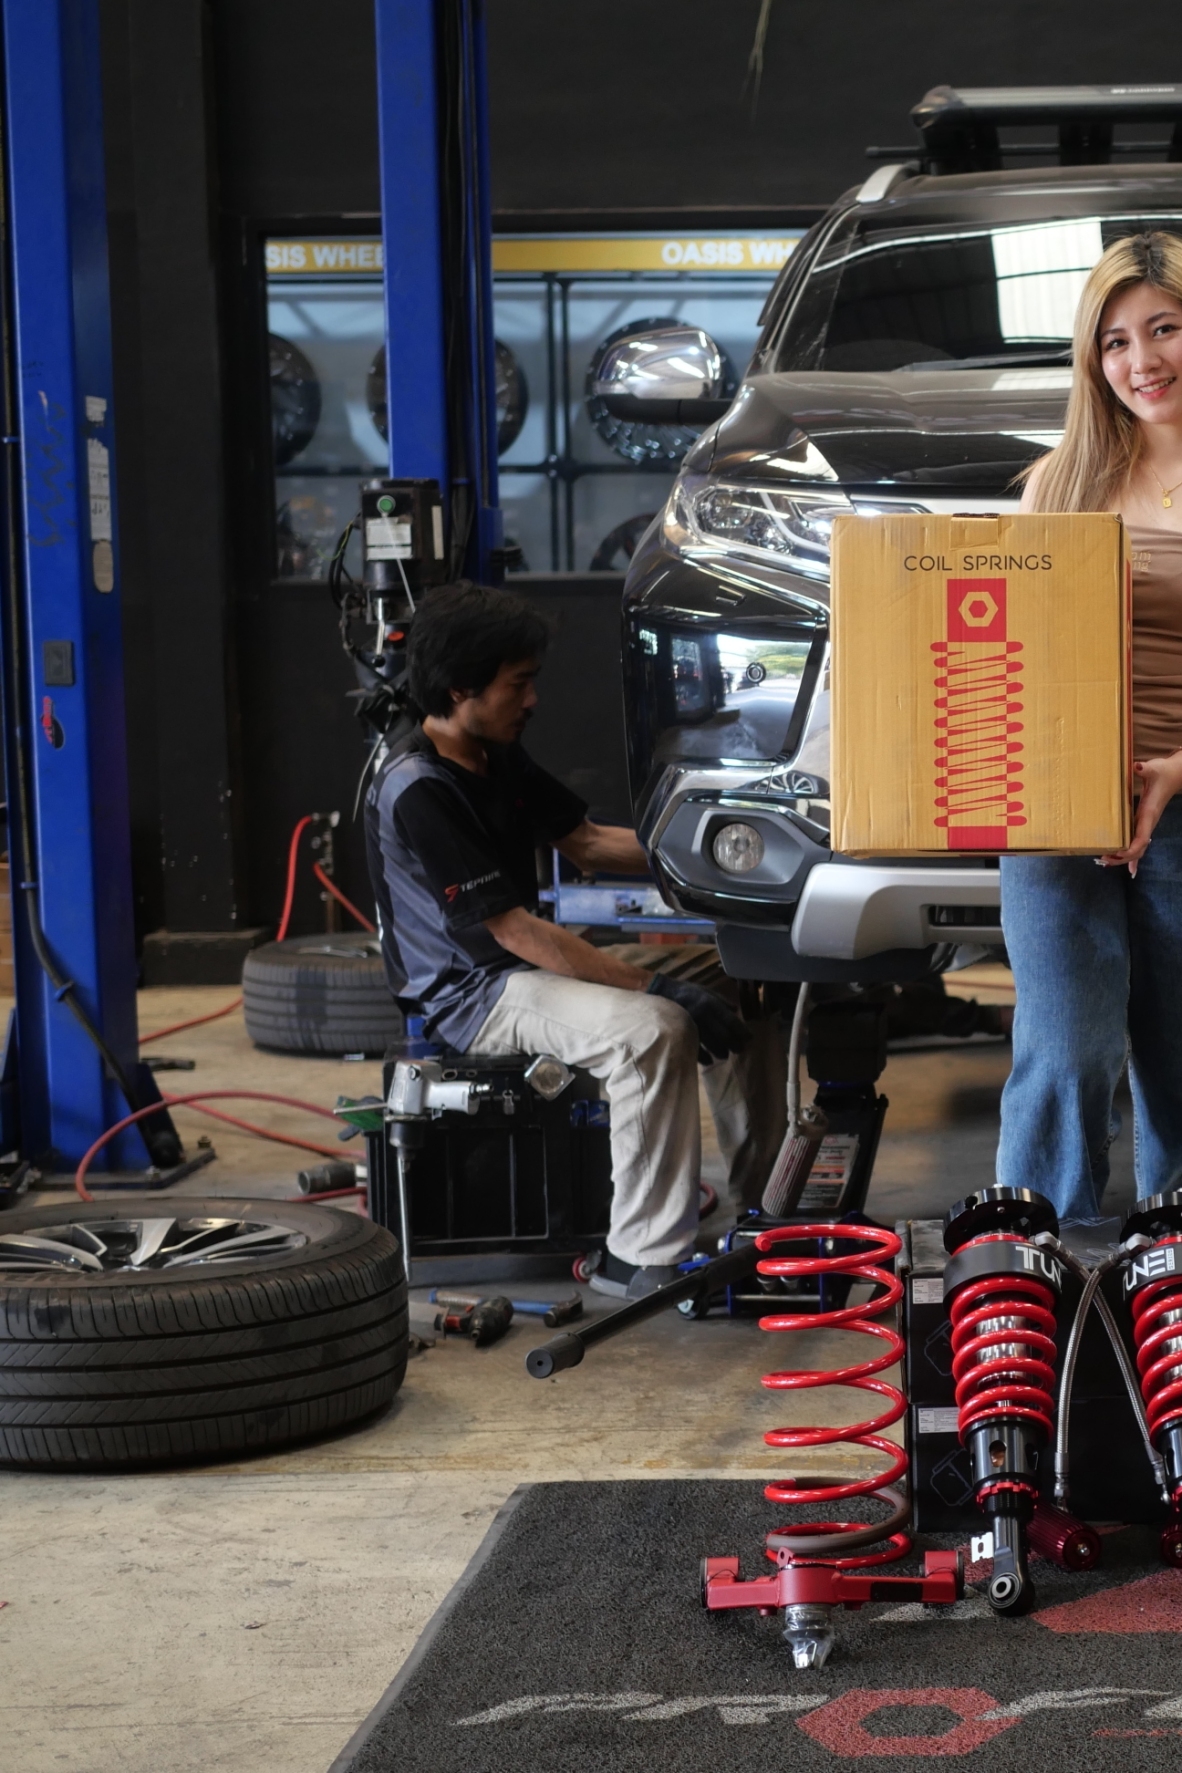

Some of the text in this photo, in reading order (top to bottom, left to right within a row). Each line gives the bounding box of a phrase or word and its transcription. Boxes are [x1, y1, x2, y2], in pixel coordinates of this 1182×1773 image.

[265, 243, 384, 267] SIS WHEE
[661, 241, 744, 265] OASIS
[903, 554, 1053, 571] COIL SPRINGS
